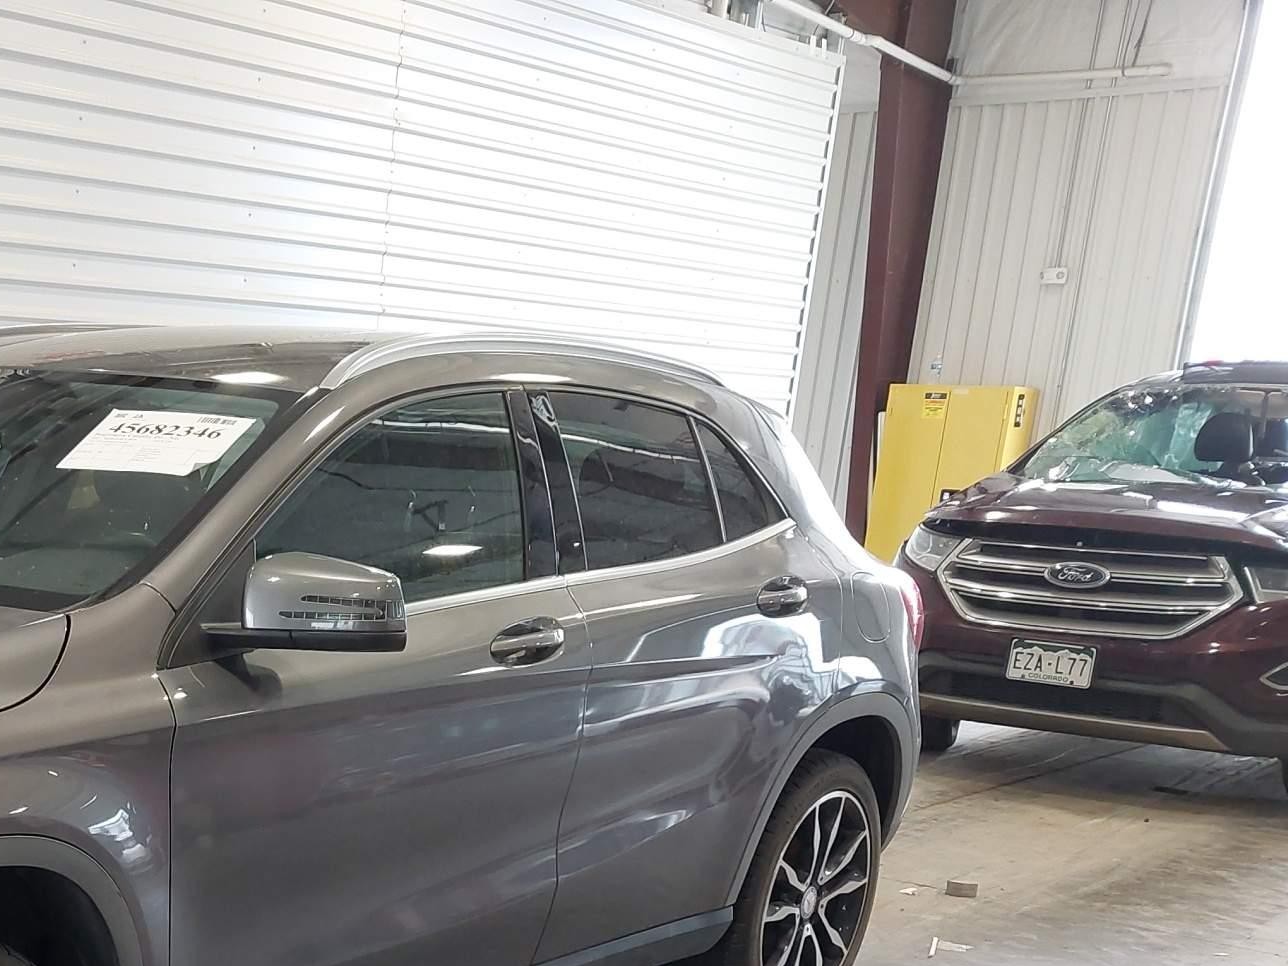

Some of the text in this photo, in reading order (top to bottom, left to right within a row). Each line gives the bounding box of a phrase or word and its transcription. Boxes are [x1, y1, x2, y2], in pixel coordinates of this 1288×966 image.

[109, 423, 223, 440] 45682346
[1057, 566, 1094, 582] Ford
[1027, 672, 1070, 683] COLORADO
